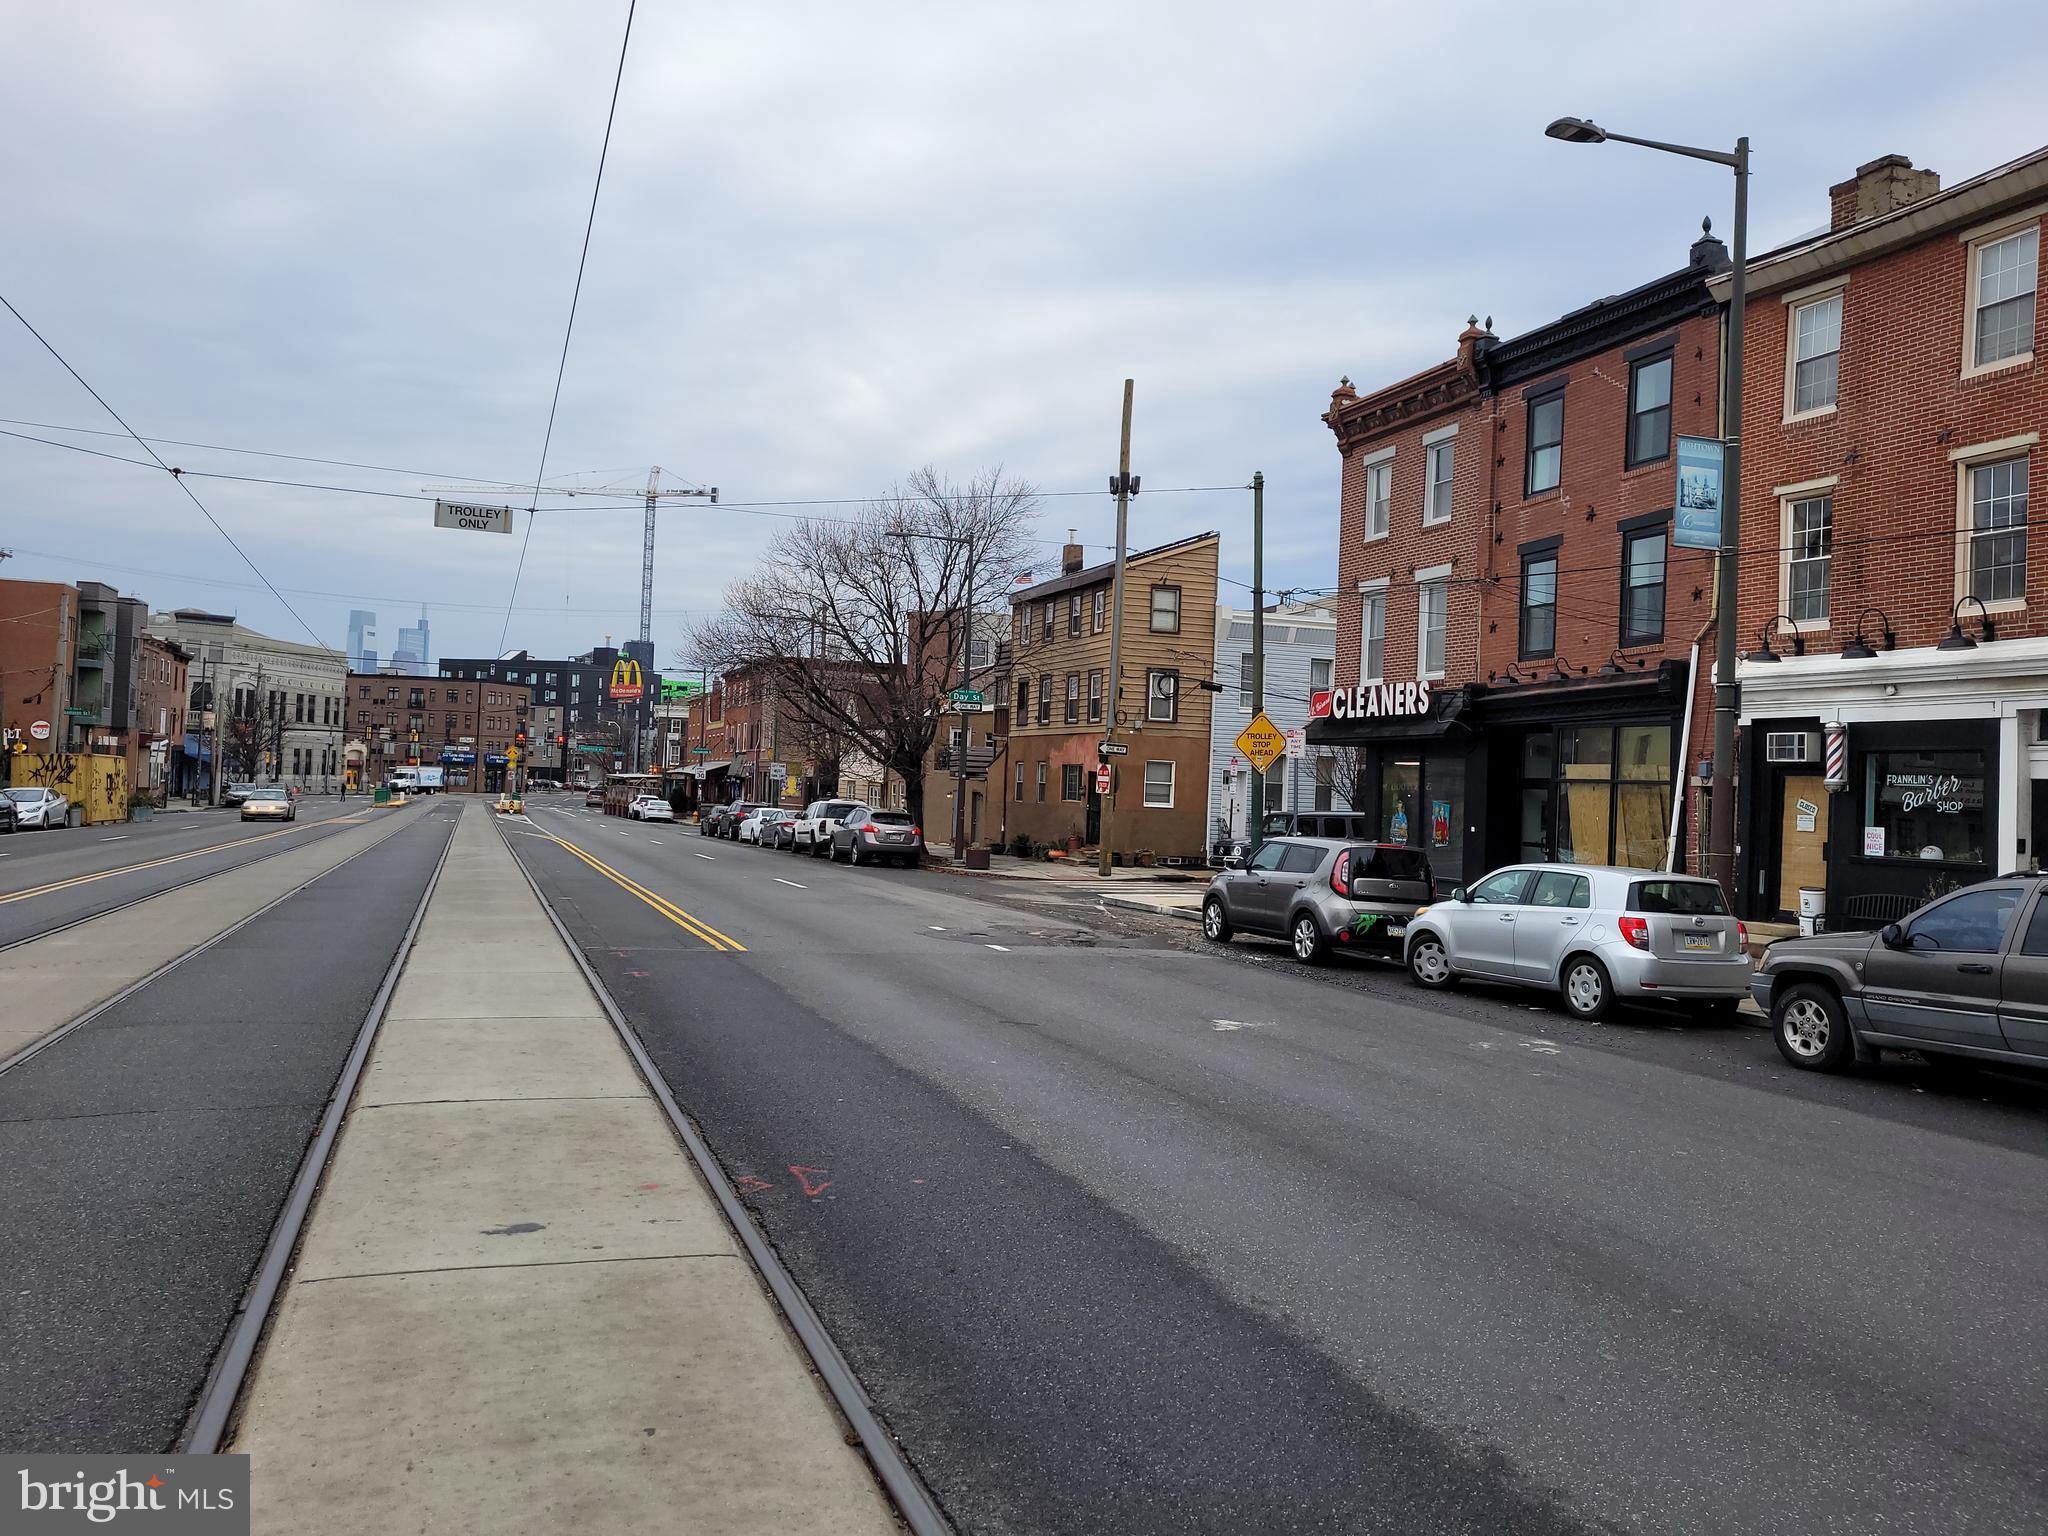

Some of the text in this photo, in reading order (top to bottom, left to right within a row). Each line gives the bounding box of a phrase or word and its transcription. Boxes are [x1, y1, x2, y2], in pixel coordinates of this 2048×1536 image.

[1680, 441, 1721, 453] FISHTOWN
[448, 505, 501, 519] TROLLEY
[458, 518, 489, 530] ONLY
[953, 693, 968, 701] Day
[1332, 680, 1430, 719] CLEANERS
[1886, 774, 1933, 785] FRANKLIN'S
[1901, 775, 1962, 812] Barber
[1799, 801, 1816, 814] CLOSED
[1936, 801, 1964, 813] SHOP
[1866, 843, 1883, 851] NICE
